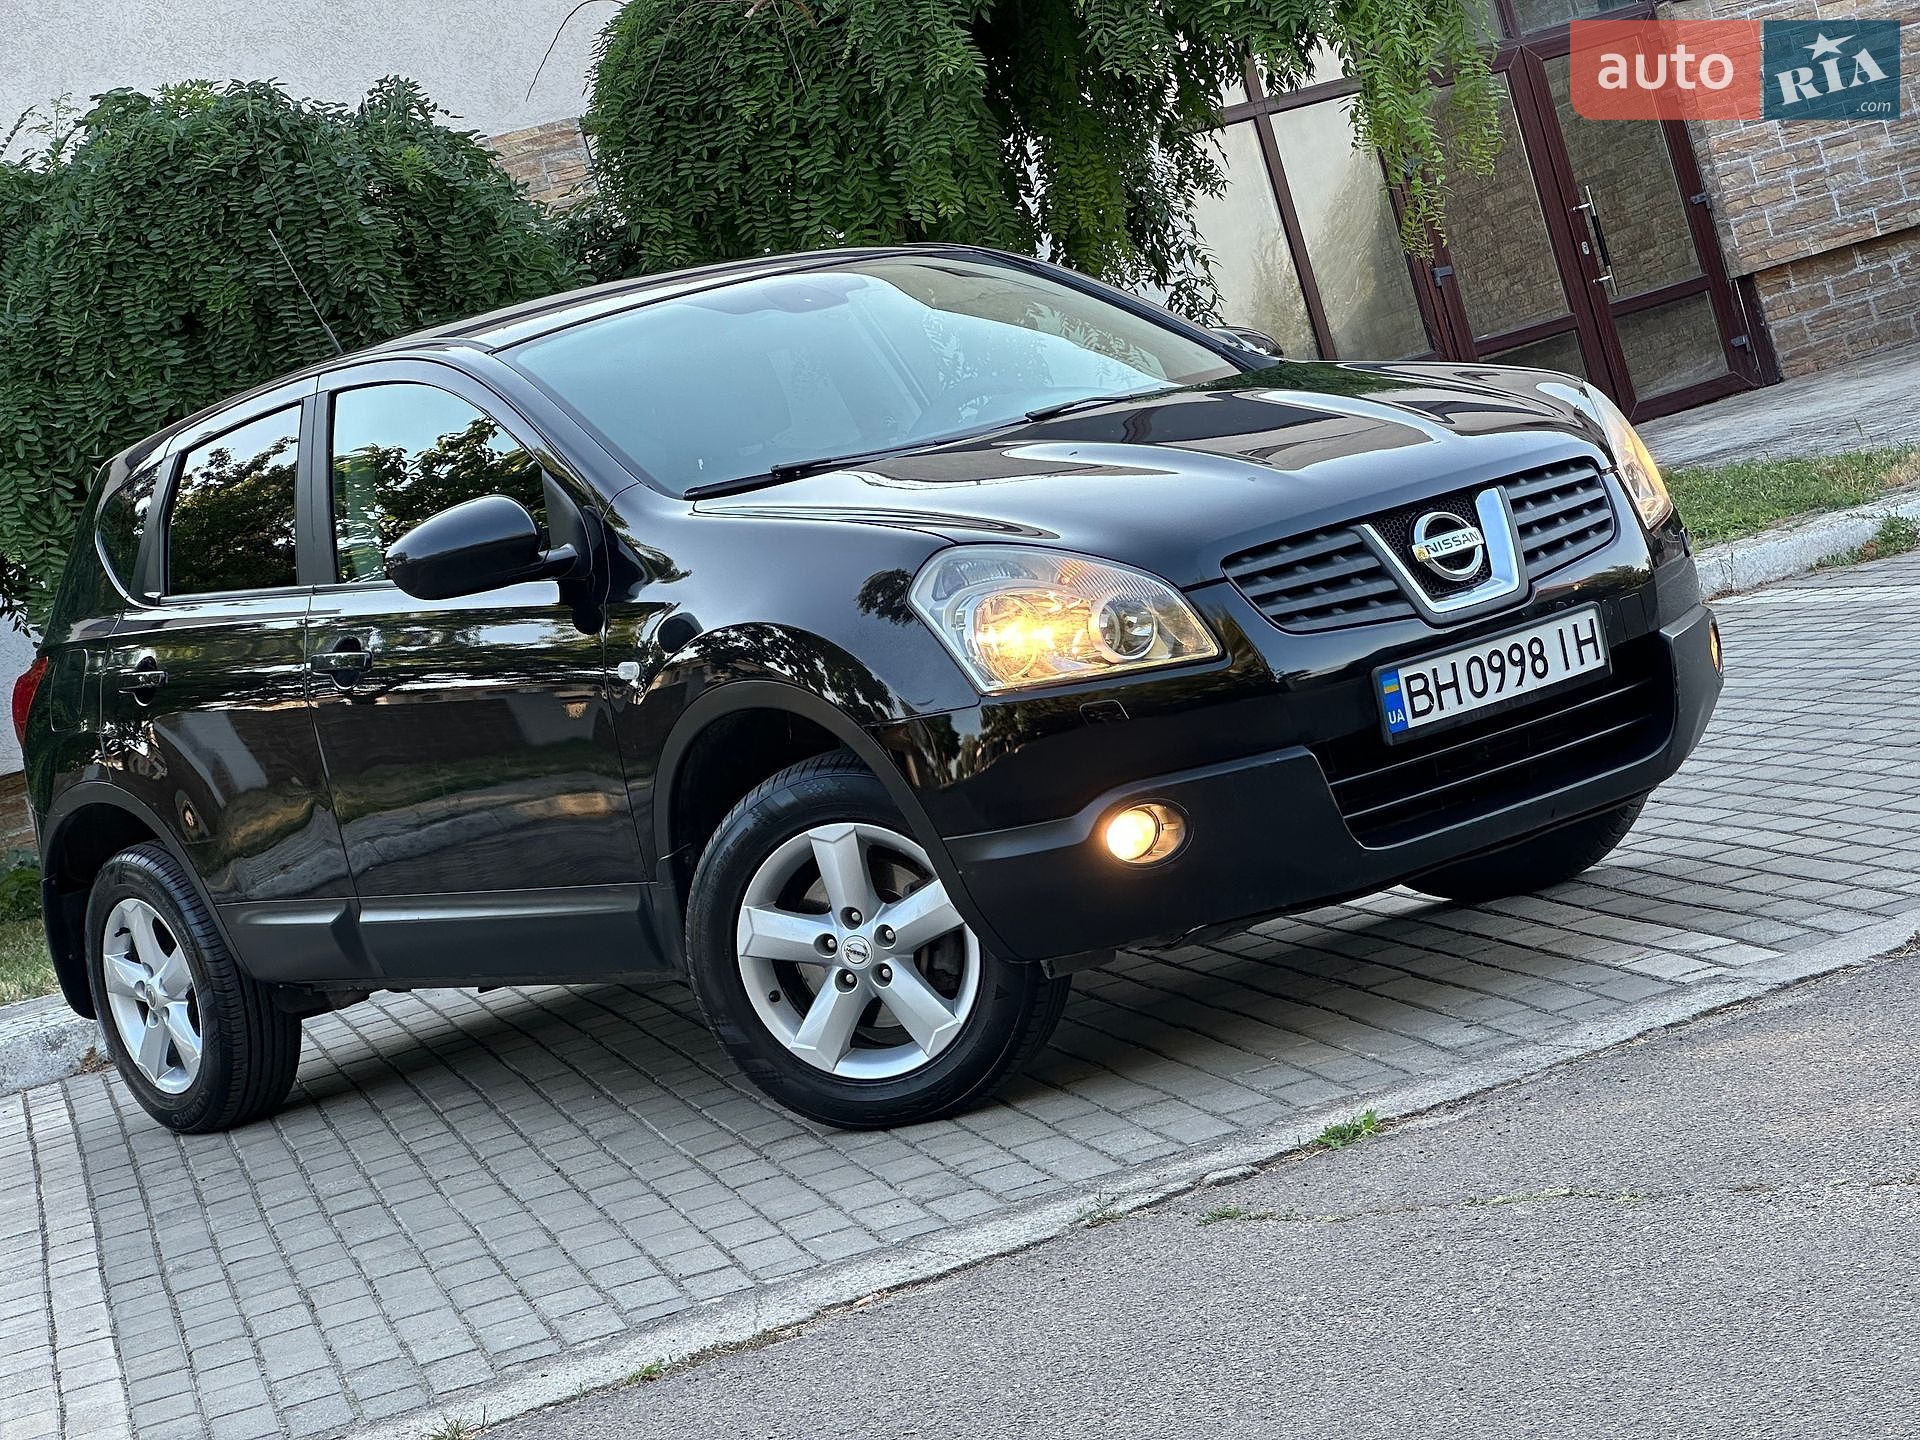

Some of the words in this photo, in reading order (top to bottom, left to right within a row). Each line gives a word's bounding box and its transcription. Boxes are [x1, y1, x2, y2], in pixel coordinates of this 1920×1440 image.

[1424, 530, 1480, 555] NISSAN
[1558, 617, 1601, 671] IH
[1388, 708, 1406, 724] UA
